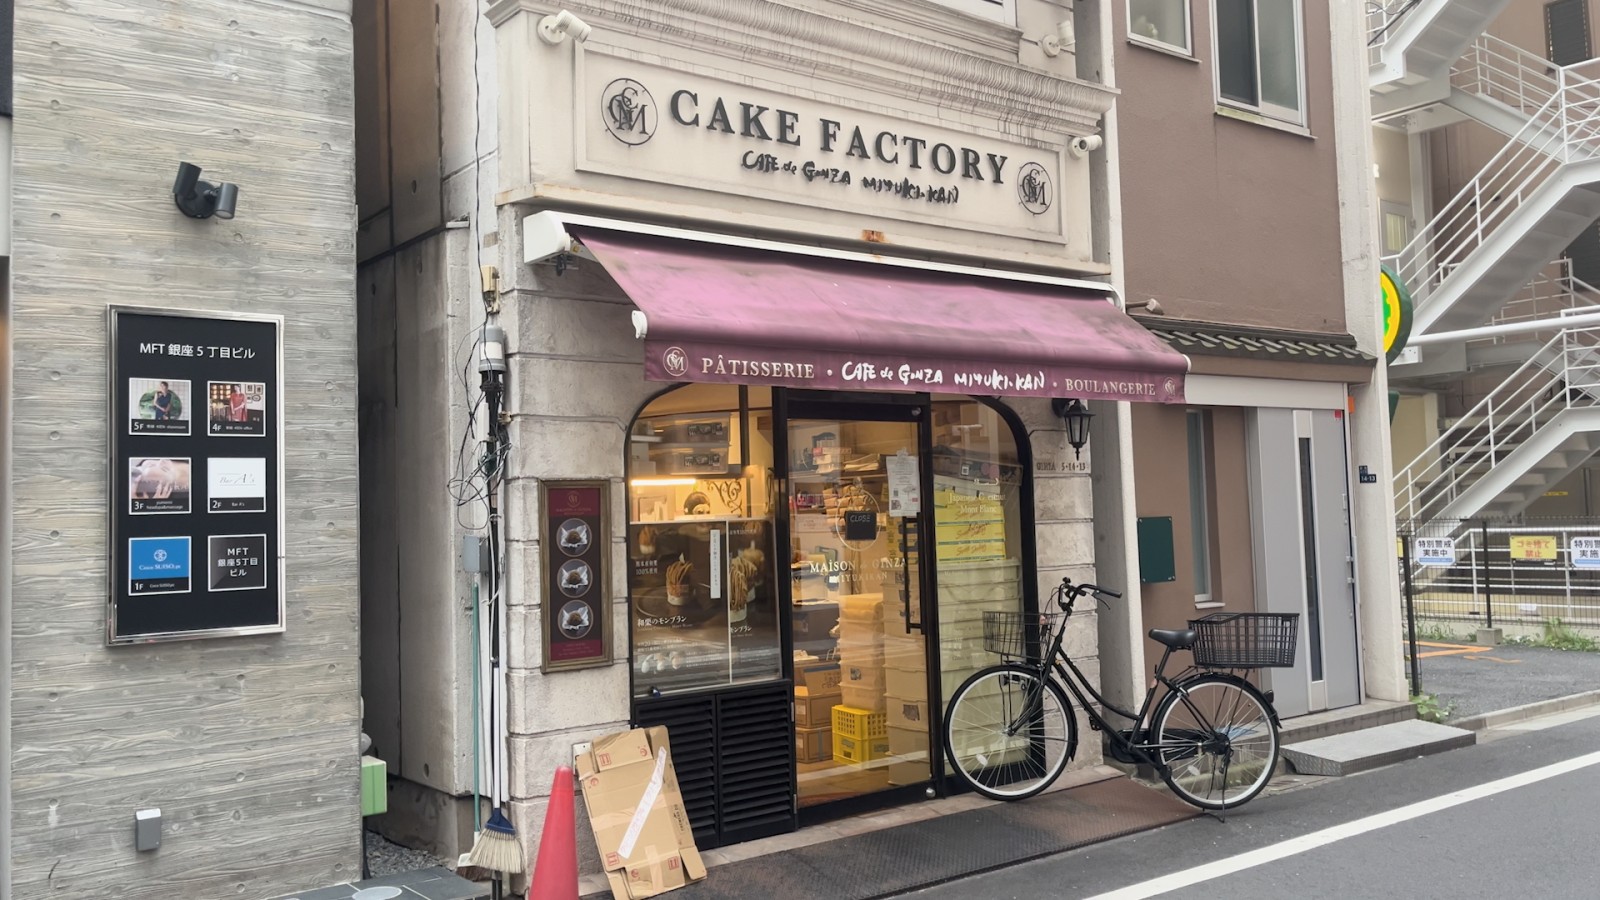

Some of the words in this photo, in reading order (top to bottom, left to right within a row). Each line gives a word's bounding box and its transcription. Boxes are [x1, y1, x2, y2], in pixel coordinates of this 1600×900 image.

[670, 89, 801, 147] CAKE
[819, 118, 1009, 185] FACTORY
[781, 160, 797, 175] de
[140, 342, 165, 355] MFT
[701, 354, 815, 379] PÂTISSERIE
[880, 366, 894, 380] de
[1065, 378, 1156, 396] BOULANGERIE
[134, 421, 144, 431] 5F
[212, 423, 222, 431] 4F
[134, 501, 144, 510] 3F
[212, 500, 222, 509] 2F
[1418, 540, 1452, 548] 特別警戒
[1517, 540, 1550, 549] ゴミ捨て
[227, 547, 249, 556] MFT
[1423, 549, 1448, 557] 実施中
[1525, 550, 1543, 558] 禁止
[217, 557, 258, 567] 銀座5丁目
[230, 568, 248, 577] ビル
[135, 582, 144, 591] 1F
